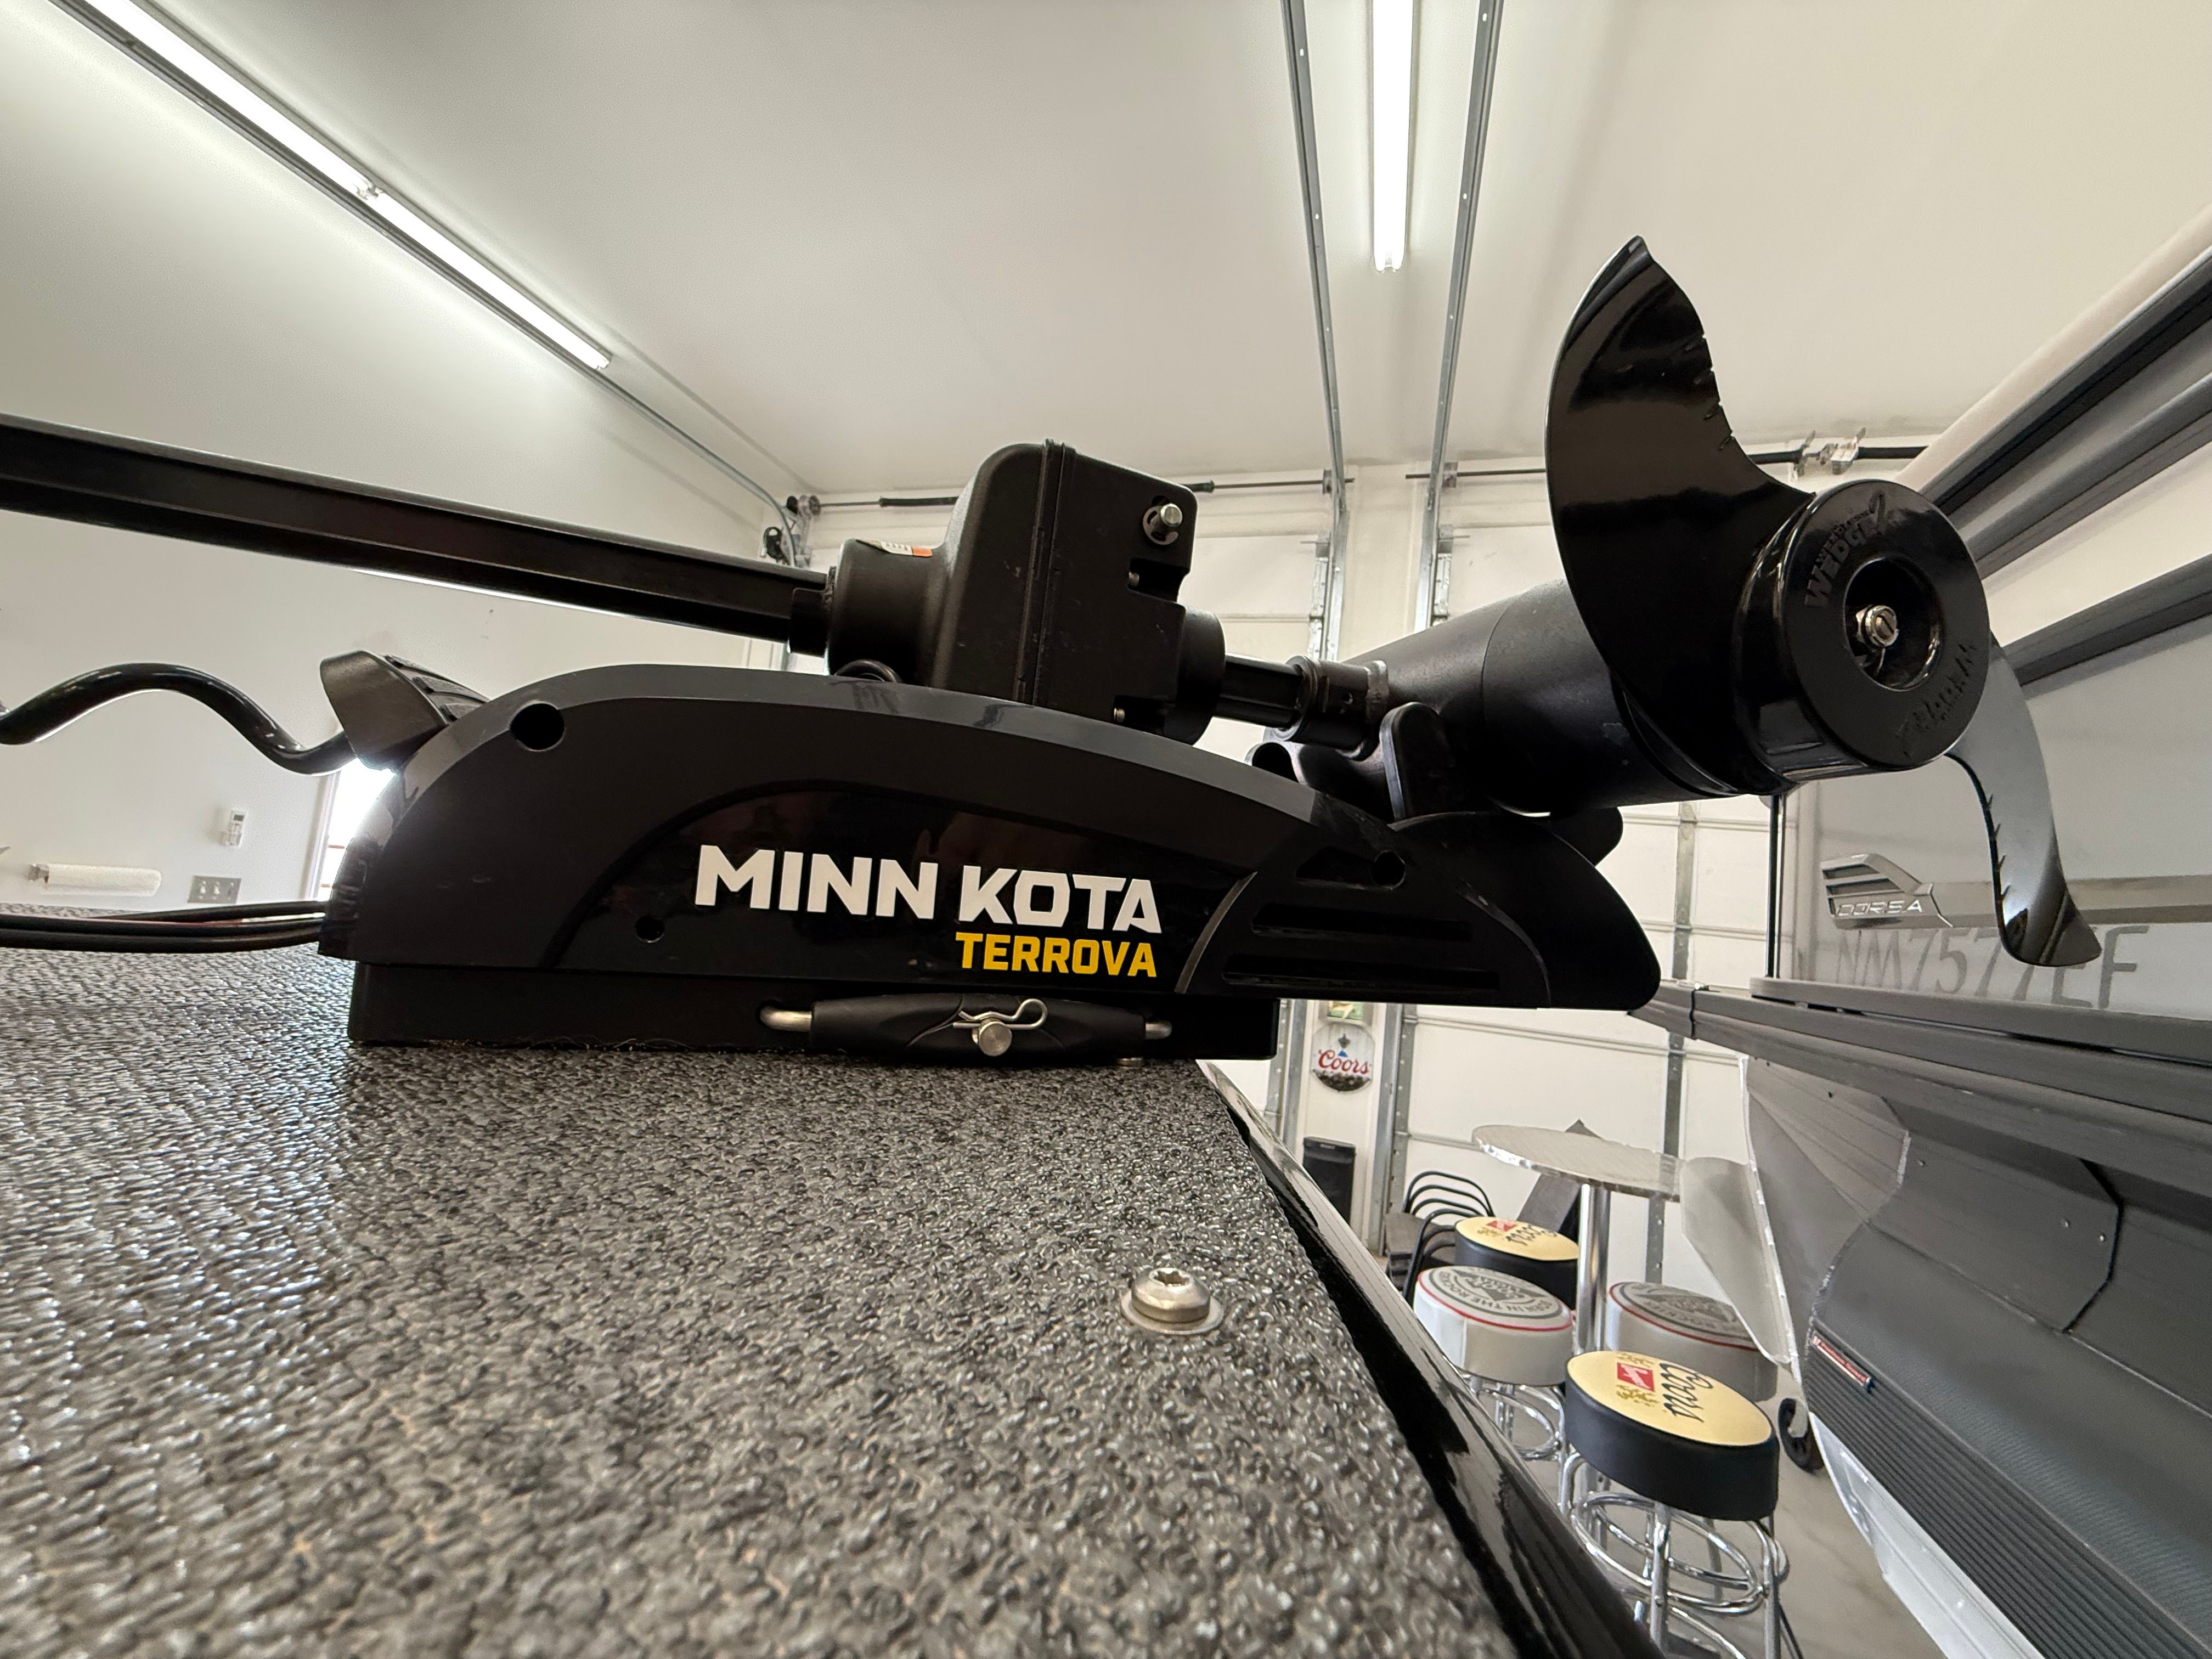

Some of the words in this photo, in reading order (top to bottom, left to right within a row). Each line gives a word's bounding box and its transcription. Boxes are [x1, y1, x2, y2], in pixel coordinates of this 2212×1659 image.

[695, 845, 938, 919] MINN
[958, 865, 1162, 933] KOTA
[956, 932, 1157, 977] TERROVA
[1318, 1049, 1369, 1074] Coors
[1659, 1363, 1714, 1423] Coors
